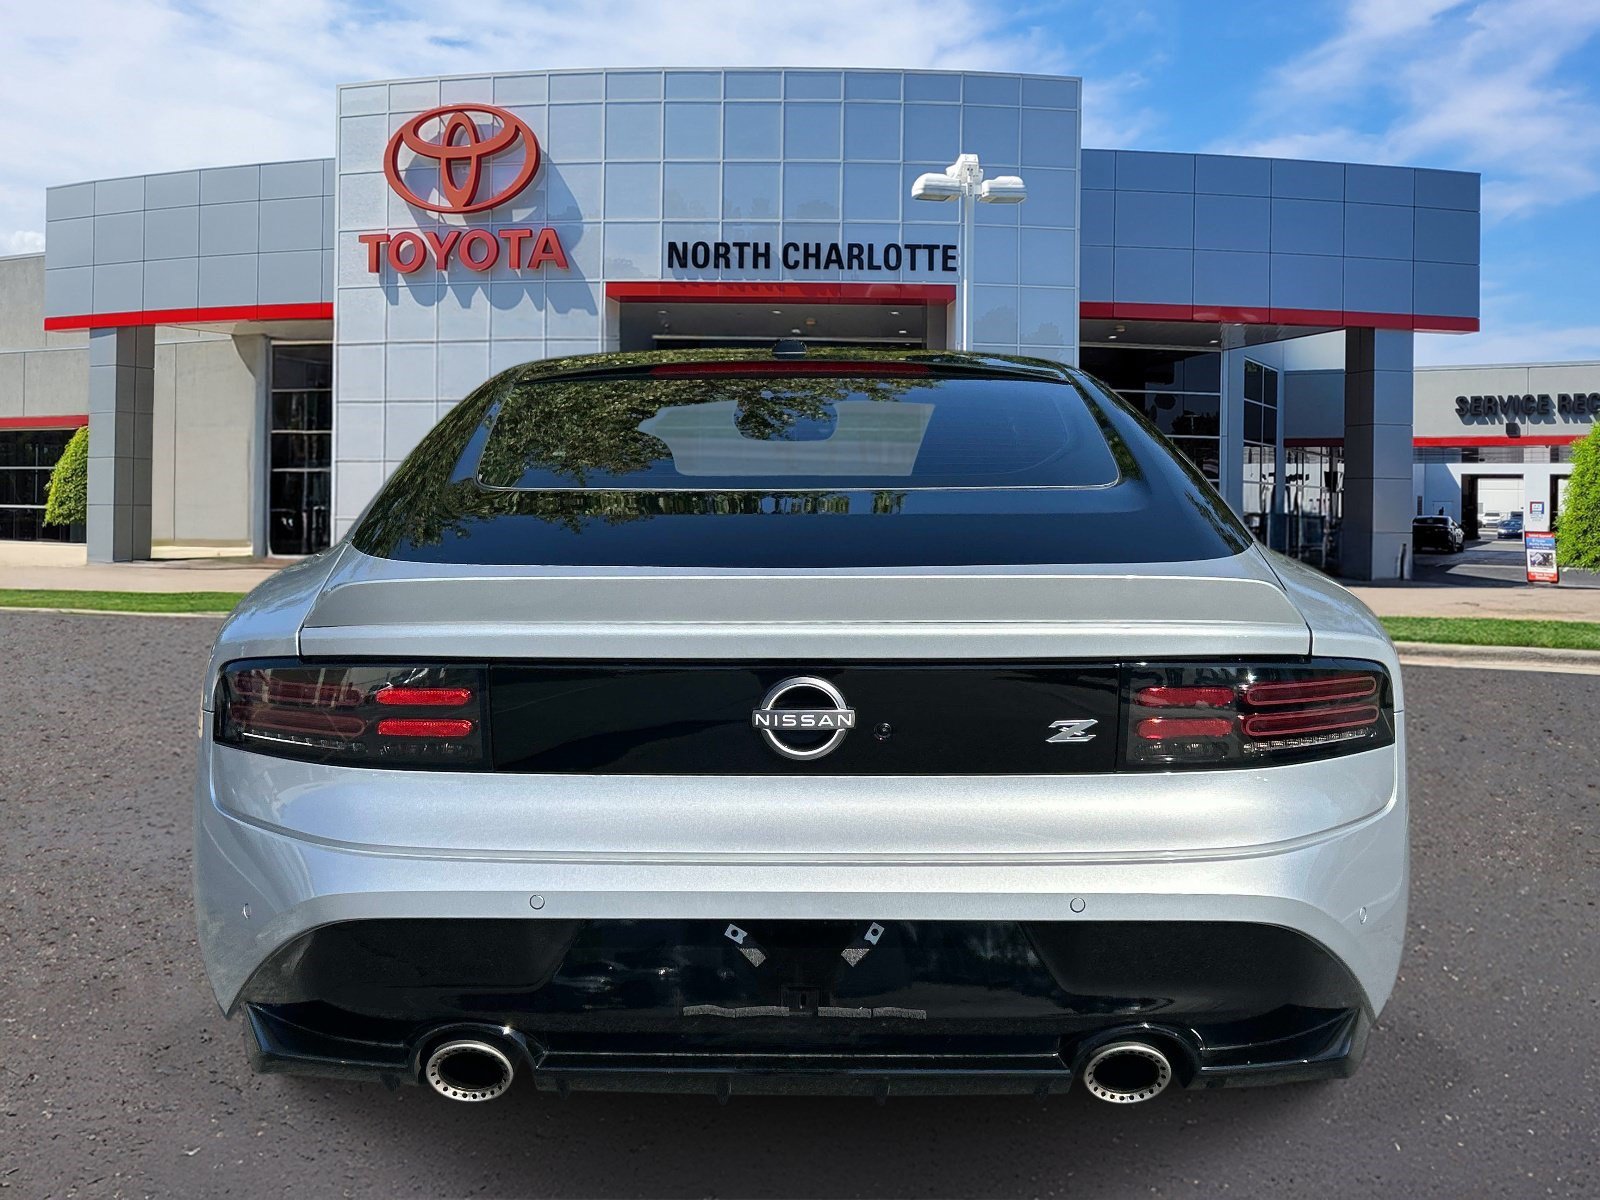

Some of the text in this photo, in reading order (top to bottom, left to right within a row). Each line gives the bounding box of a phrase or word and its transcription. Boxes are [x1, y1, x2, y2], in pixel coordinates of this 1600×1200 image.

[359, 228, 569, 274] TOYOTA
[667, 241, 958, 272] NORTH CHARLOTTE
[1455, 394, 1551, 416] SERVICE
[755, 713, 853, 727] NISSAN
[1045, 718, 1099, 743] Z
